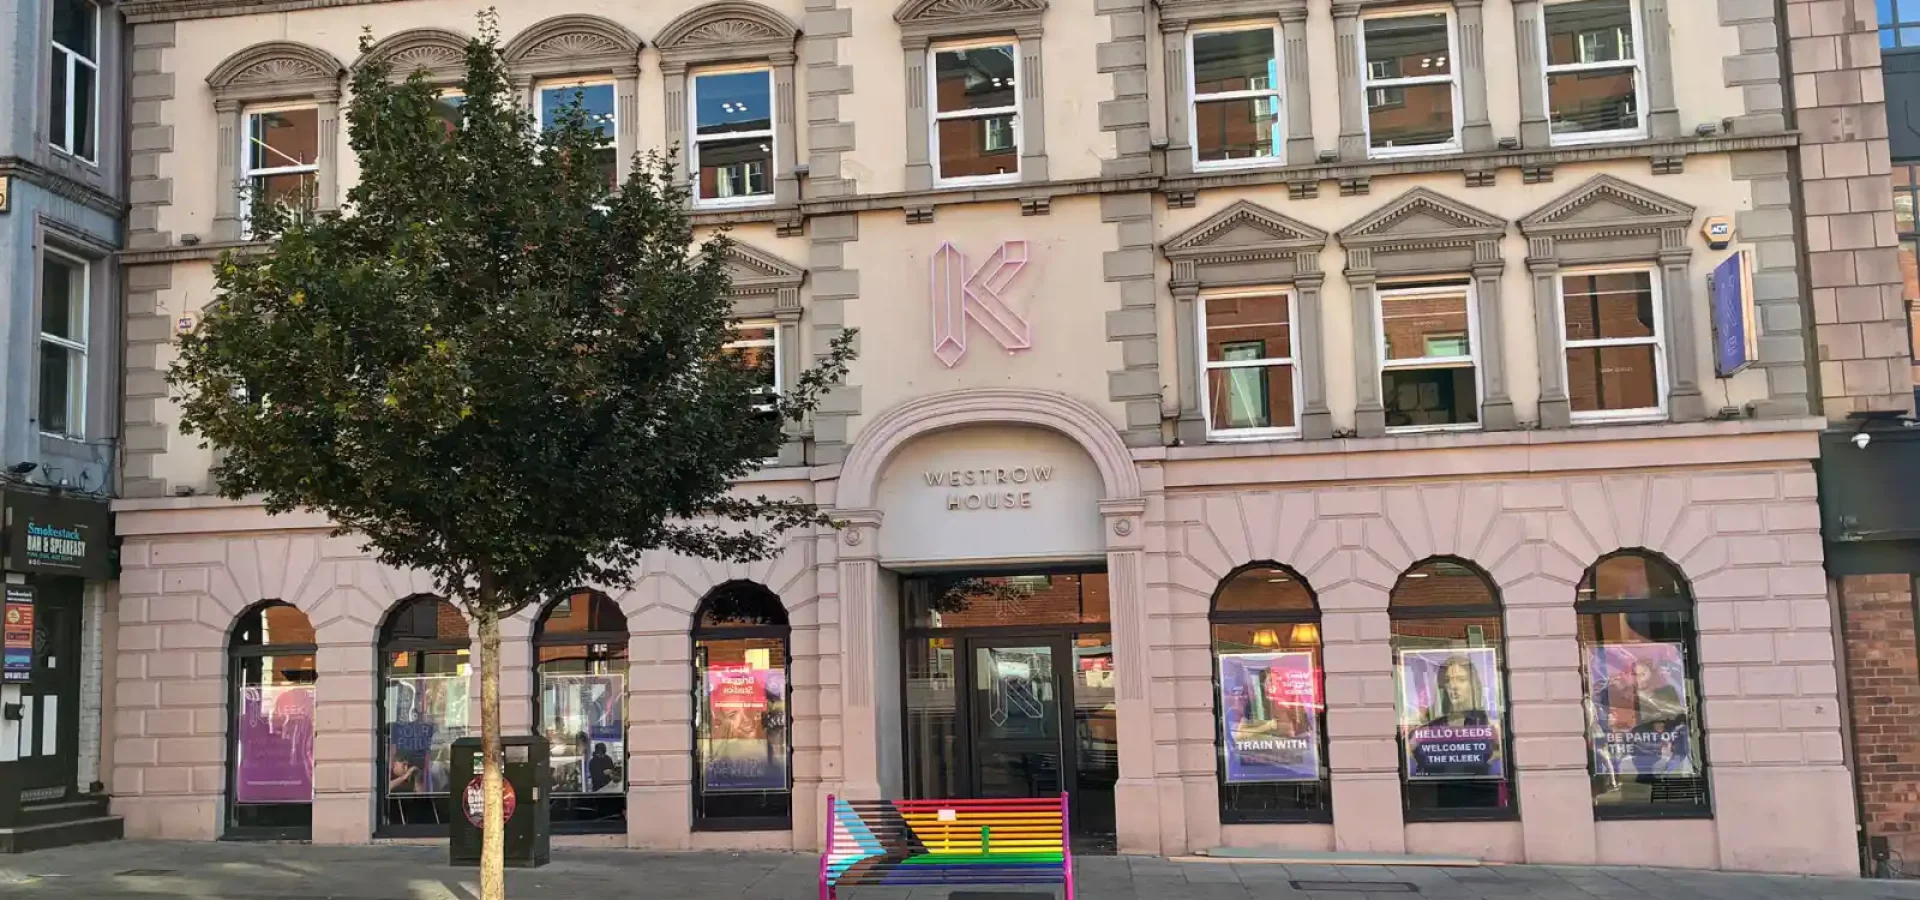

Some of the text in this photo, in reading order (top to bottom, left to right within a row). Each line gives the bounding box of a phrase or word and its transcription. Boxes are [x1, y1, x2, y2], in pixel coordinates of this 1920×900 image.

[1711, 225, 1728, 233] ADT
[931, 240, 1031, 367] K
[924, 466, 1052, 487] WESTROW
[946, 492, 1032, 511] HOUSE
[28, 522, 81, 540] Smokestack
[27, 534, 42, 552] BAR
[43, 537, 49, 553] &
[49, 537, 86, 557] SPEAKEASY
[1415, 727, 1493, 739] HELLO LEEDS
[1607, 731, 1679, 742] BE PART OF
[1236, 739, 1307, 751] TRAIN WITH
[1422, 743, 1486, 752] WELCOME TO
[1608, 743, 1634, 753] THE
[1428, 754, 1481, 763] THE KLEEK
